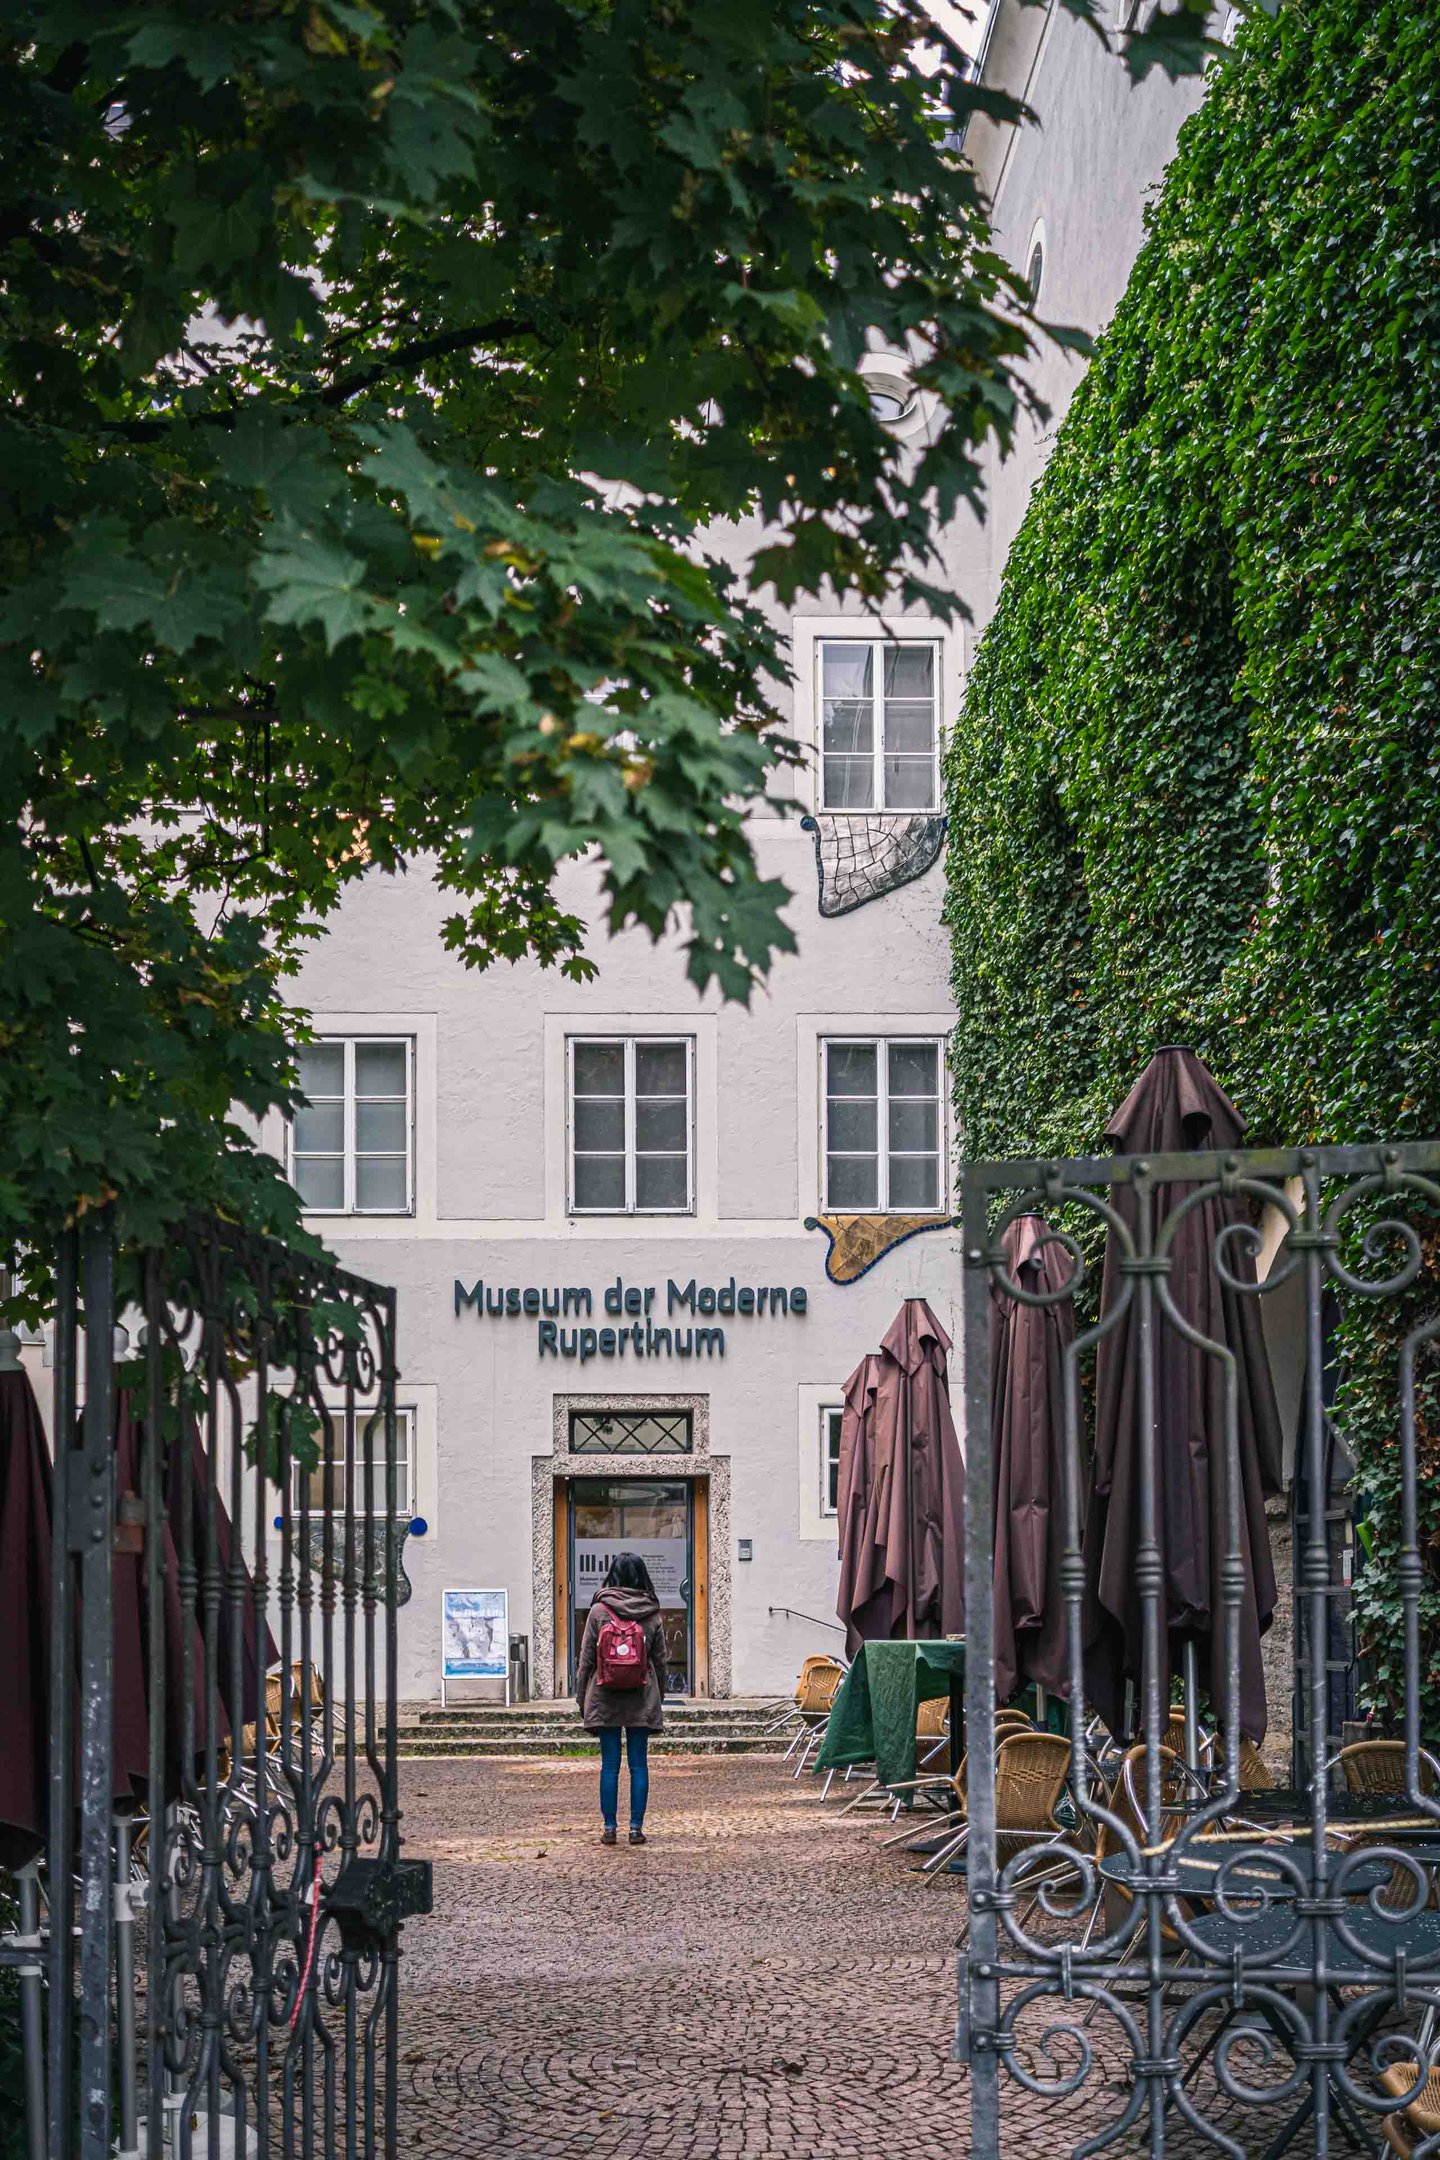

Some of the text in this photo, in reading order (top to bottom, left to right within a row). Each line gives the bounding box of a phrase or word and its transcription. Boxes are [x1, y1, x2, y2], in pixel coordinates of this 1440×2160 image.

[454, 1277, 808, 1316] Museum der Moderne
[538, 1318, 725, 1363] Rupertinum
